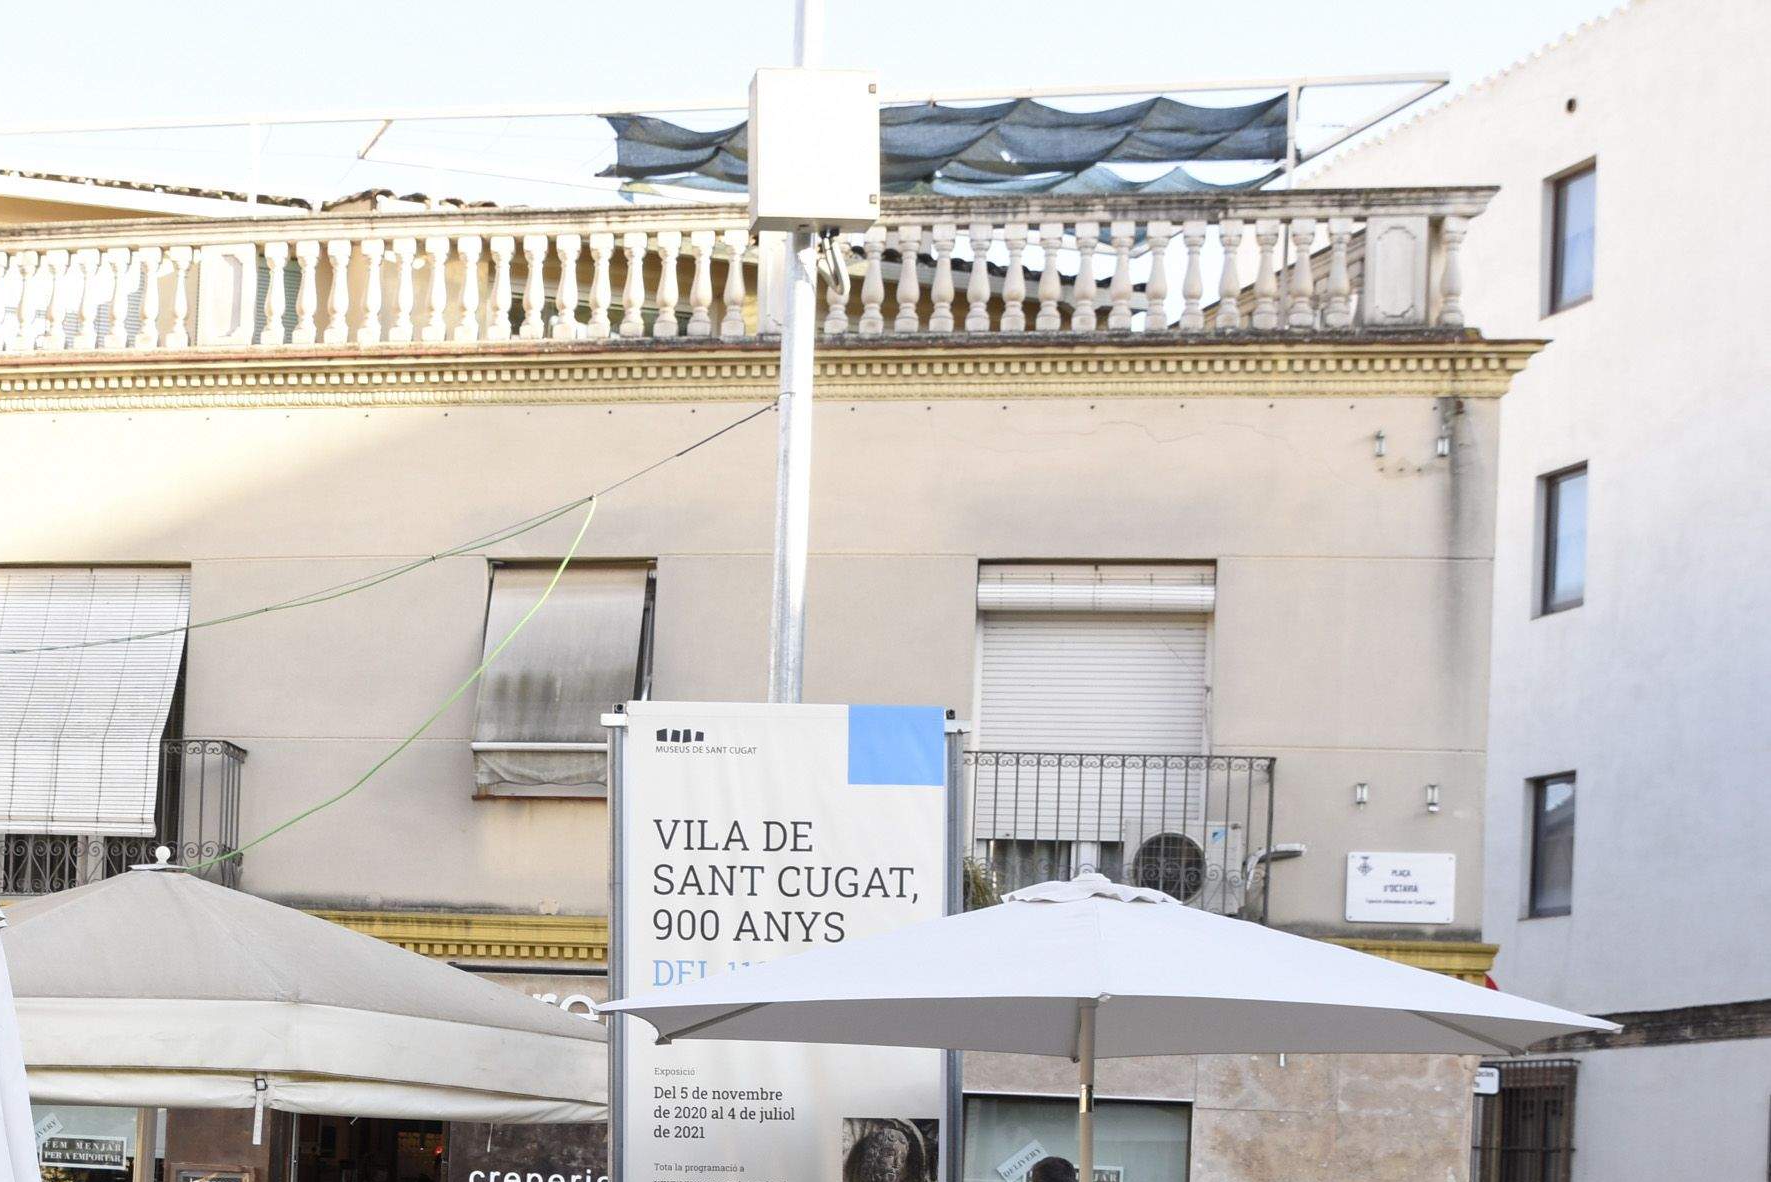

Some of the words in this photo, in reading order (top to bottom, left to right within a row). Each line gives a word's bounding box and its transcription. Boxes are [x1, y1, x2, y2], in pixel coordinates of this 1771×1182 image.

[655, 745, 690, 754] MUSEUS
[692, 746, 704, 754] DE
[705, 746, 727, 755] SANT
[729, 746, 758, 755] CUGAT
[653, 819, 750, 852] VILA
[762, 821, 813, 853] DE
[653, 863, 764, 897] SANT
[777, 866, 919, 905] CUGAT,
[653, 908, 720, 942] 900
[733, 910, 846, 943] ANYS
[654, 1067, 696, 1077] Exposició
[653, 1086, 677, 1099] Del
[680, 1087, 688, 1099] 5
[691, 1086, 708, 1100] de
[711, 1087, 783, 1101] novembre
[653, 1105, 671, 1119] de
[674, 1106, 708, 1119] 2020
[711, 1106, 724, 1120] al
[727, 1107, 736, 1120] 4
[739, 1107, 756, 1120] de
[759, 1106, 795, 1123] juliol
[653, 1125, 671, 1139] de
[673, 1126, 706, 1139] 2021
[44, 1140, 68, 1149] FEM
[75, 1141, 122, 1152] MENJAR
[44, 1151, 63, 1160] PER
[64, 1152, 71, 1160] A
[72, 1152, 122, 1163] EMPORTAR
[1002, 1148, 1042, 1178] DELIVERY
[654, 1162, 673, 1172] Tota
[674, 1163, 683, 1172] la
[684, 1163, 738, 1174] programació
